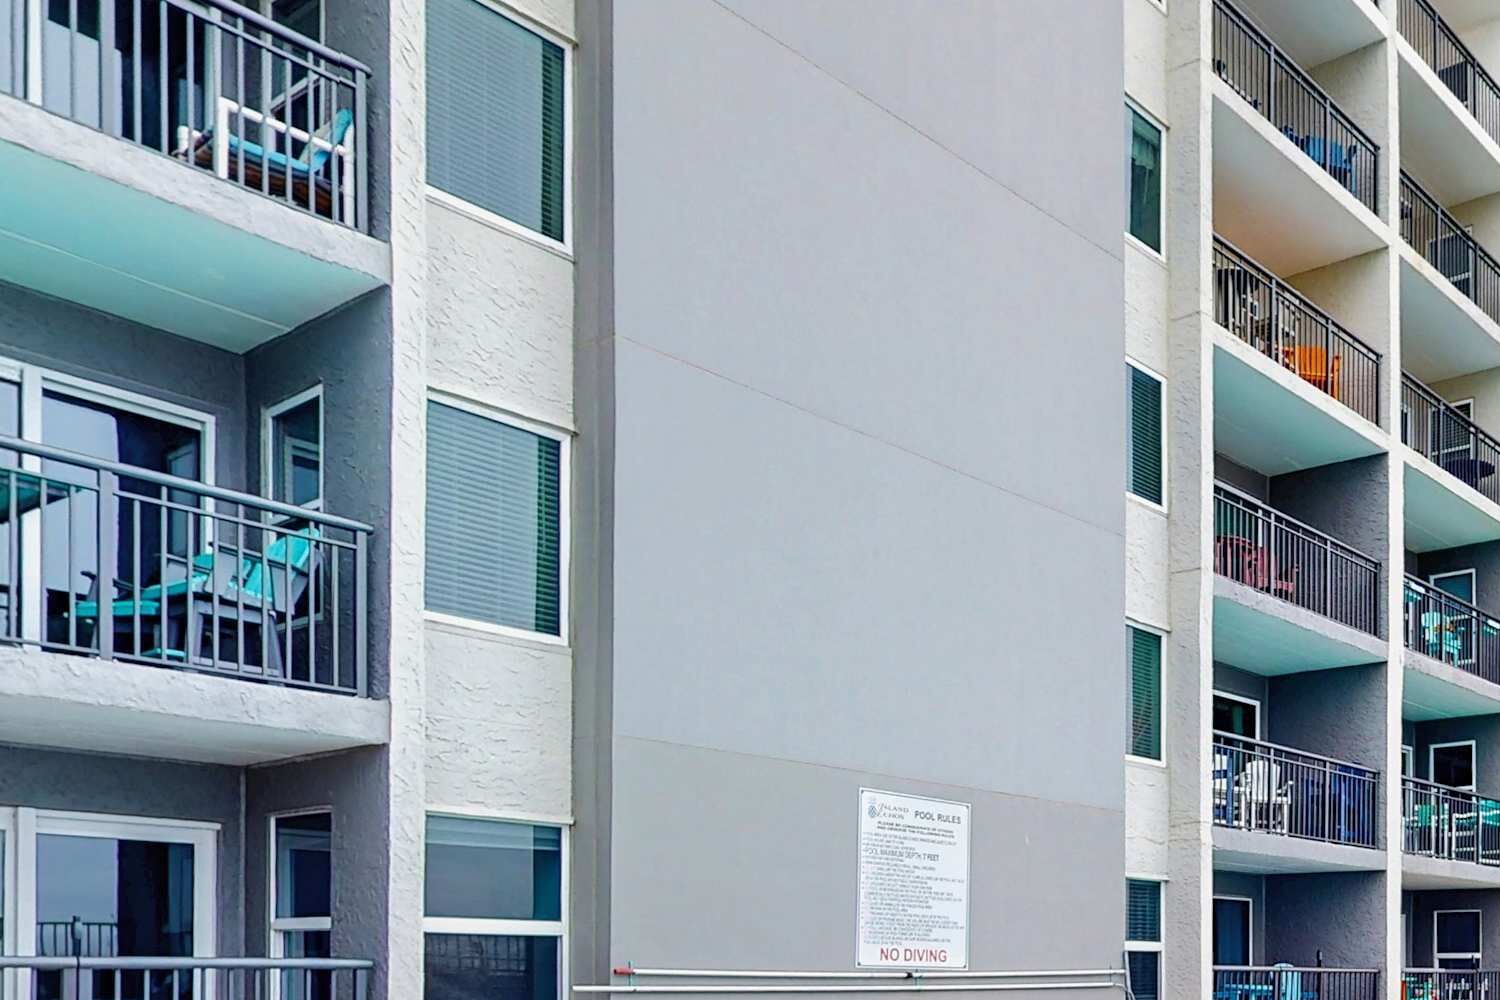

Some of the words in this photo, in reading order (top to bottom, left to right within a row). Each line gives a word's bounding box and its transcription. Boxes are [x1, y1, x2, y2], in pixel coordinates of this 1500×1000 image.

[914, 810, 935, 822] POOL
[937, 813, 961, 825] RULES
[880, 947, 900, 961] NO
[904, 948, 947, 963] DIVING
